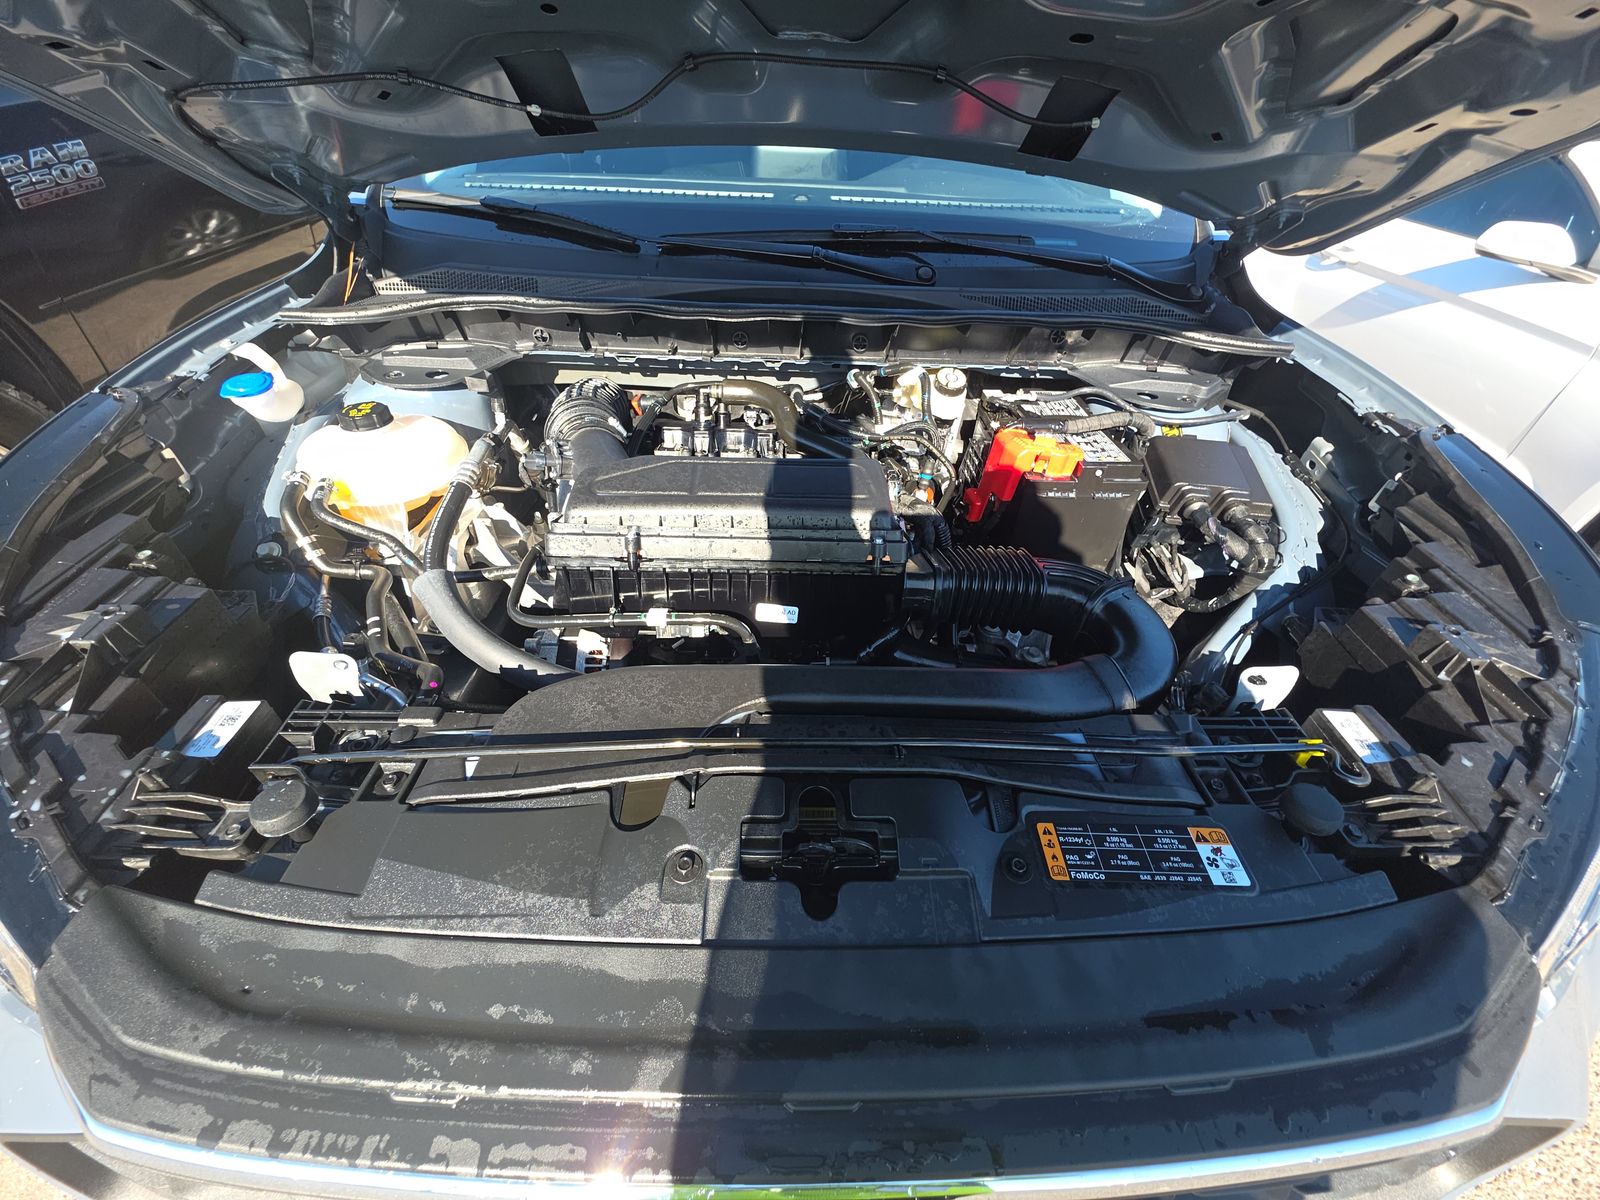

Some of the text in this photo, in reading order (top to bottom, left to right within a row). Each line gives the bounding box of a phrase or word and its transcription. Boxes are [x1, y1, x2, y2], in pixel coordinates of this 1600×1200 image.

[0, 139, 89, 176] RAM
[5, 159, 98, 196] 2500
[1071, 872, 1105, 880] FoMoCo
